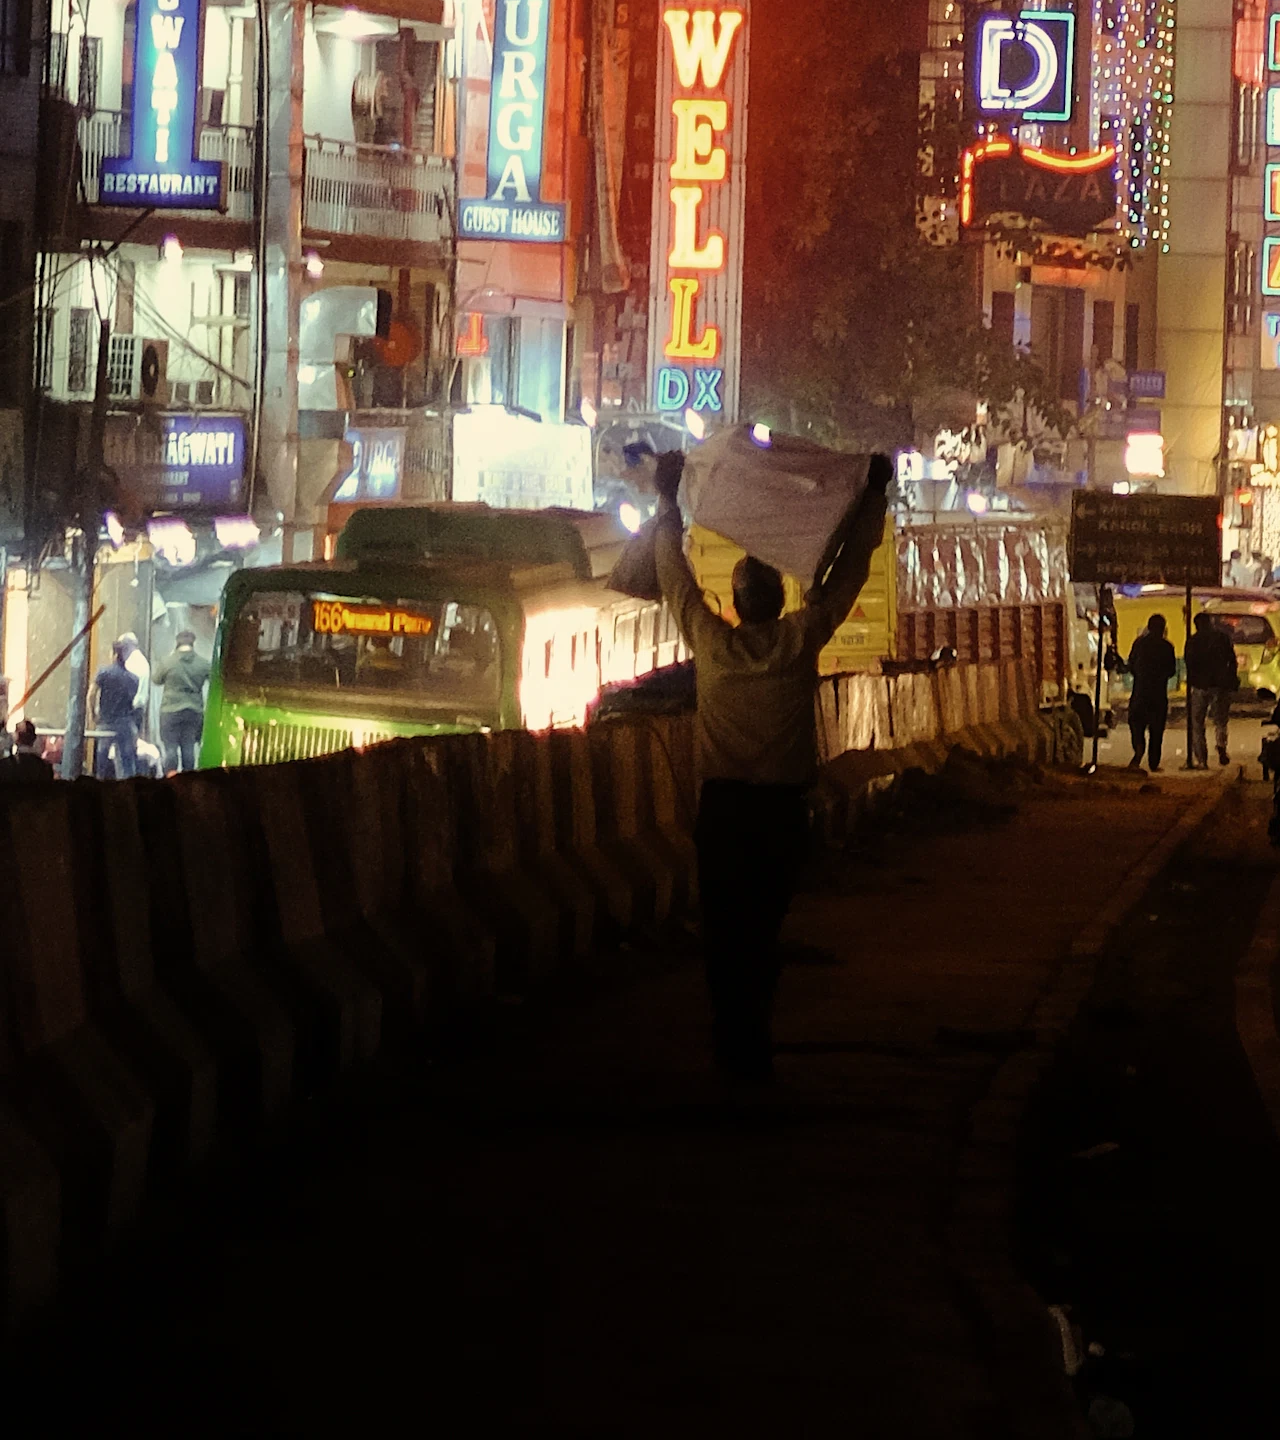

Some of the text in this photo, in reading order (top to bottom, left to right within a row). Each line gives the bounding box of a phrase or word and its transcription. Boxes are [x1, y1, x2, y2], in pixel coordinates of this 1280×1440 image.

[103, 172, 218, 197] RESTAURANT
[461, 207, 561, 237] GUEST HOUSE
[657, 366, 722, 412] DX
[313, 601, 343, 633] 166
